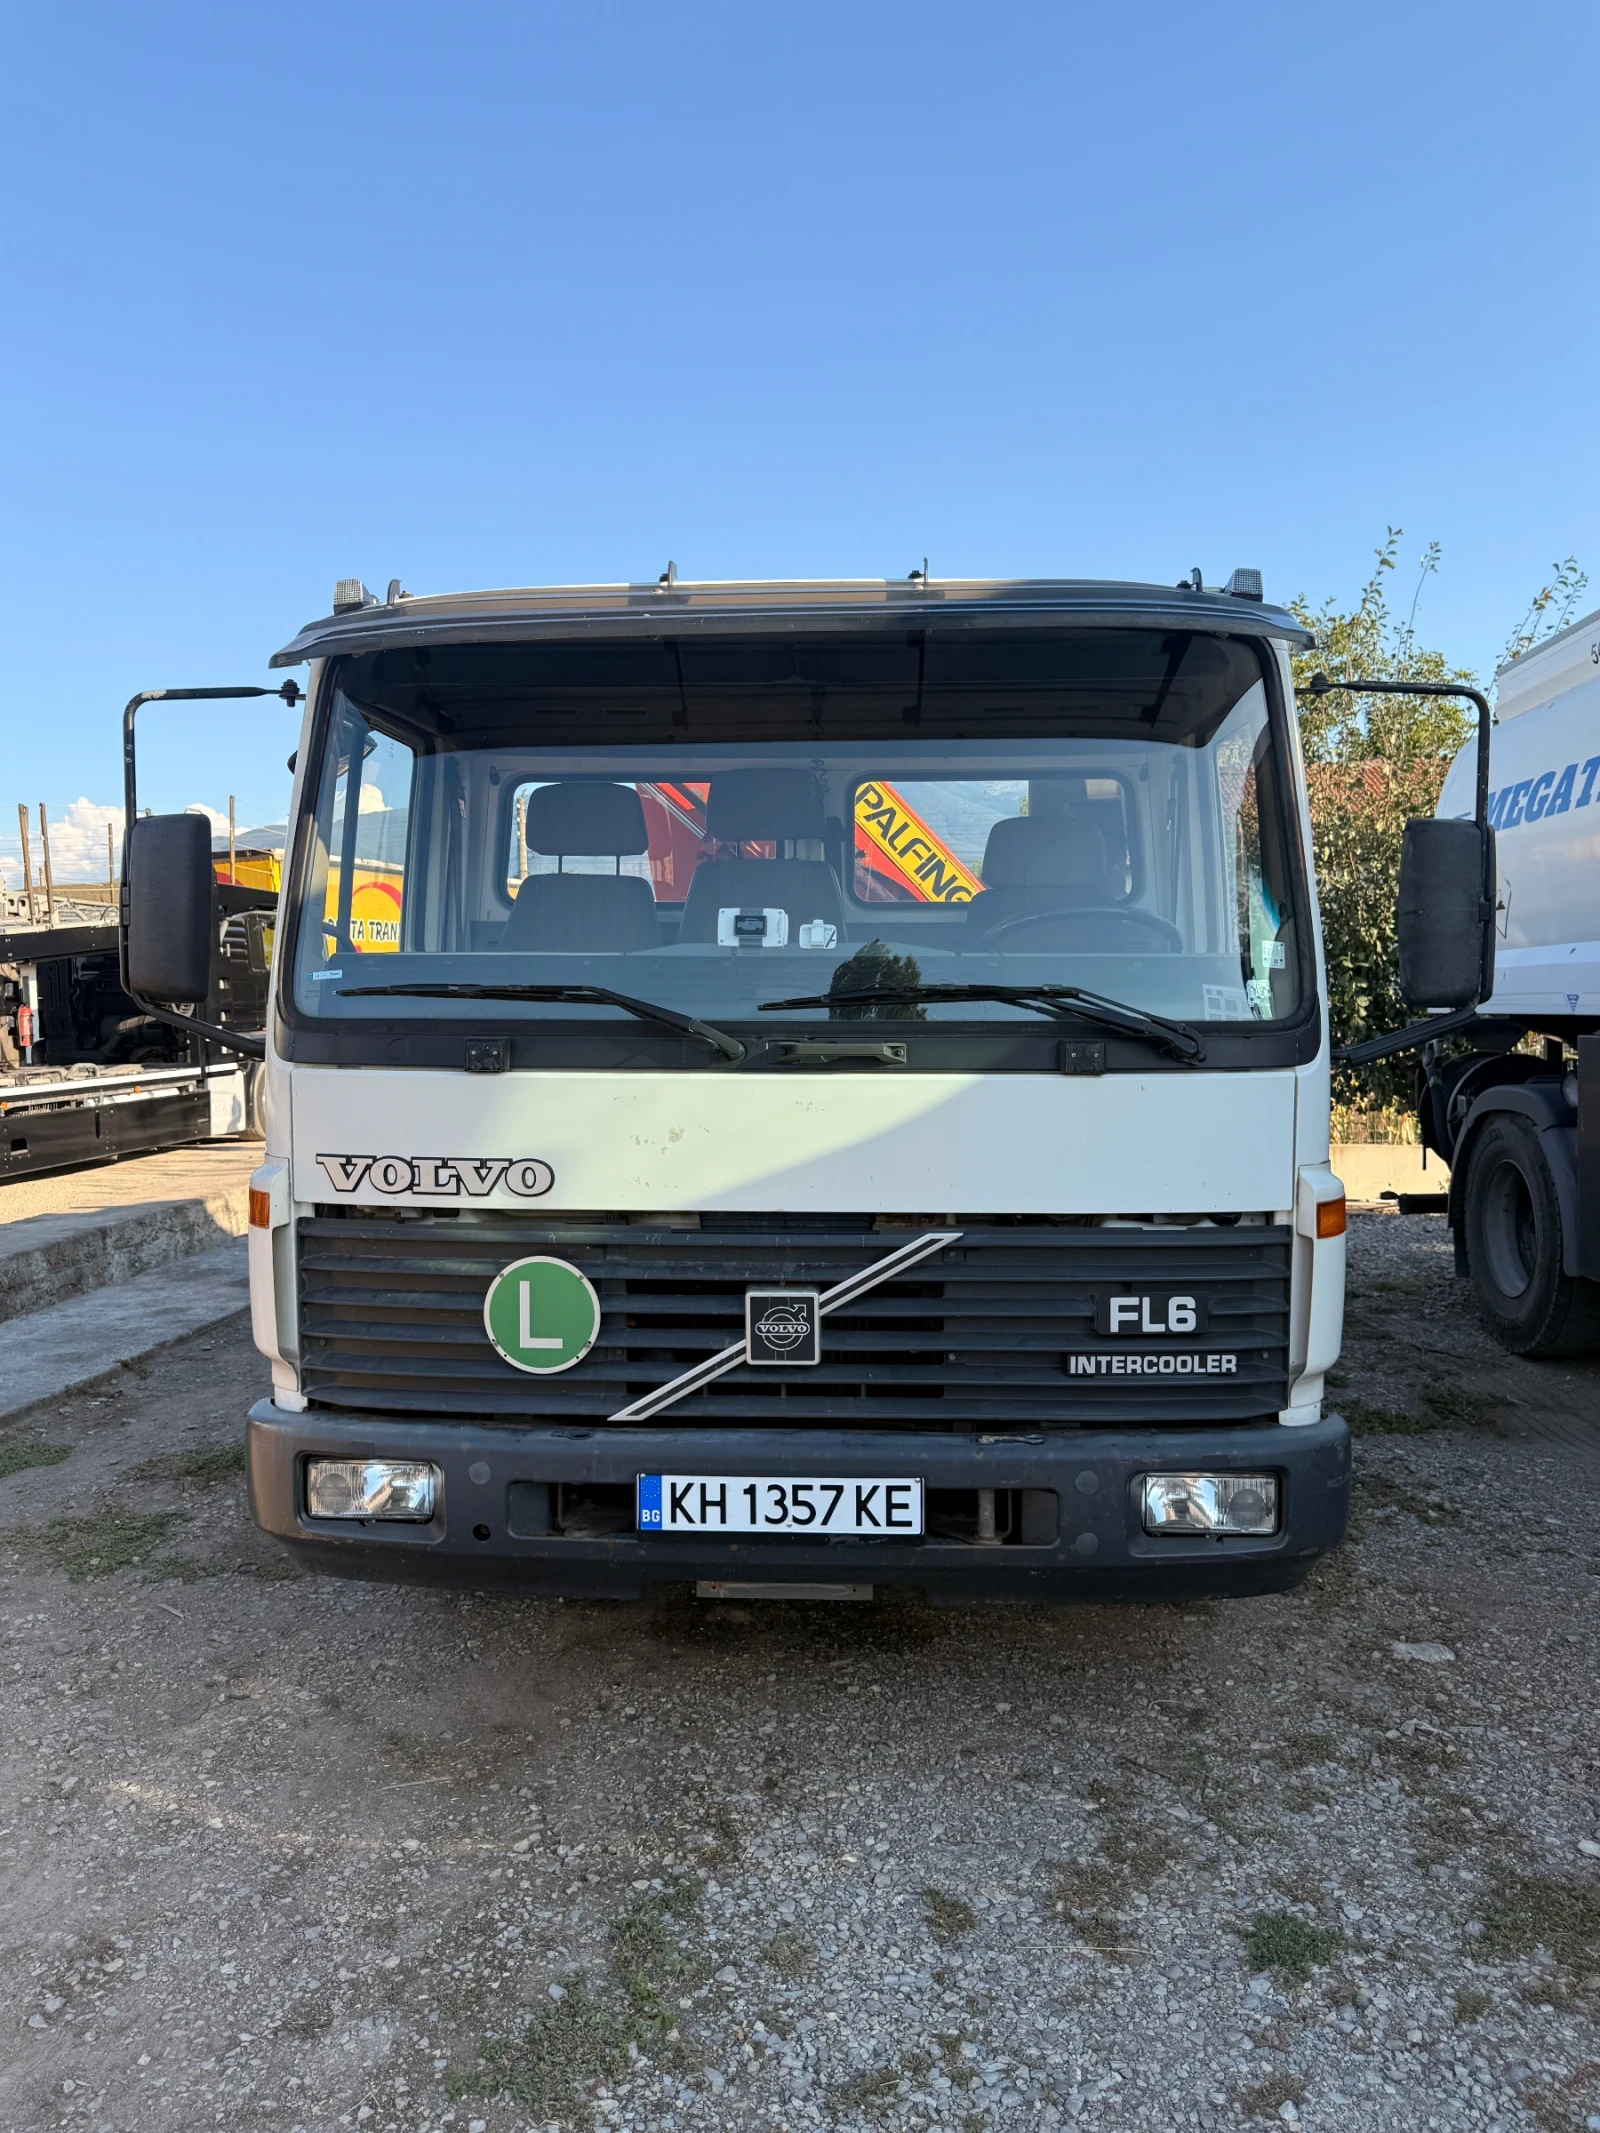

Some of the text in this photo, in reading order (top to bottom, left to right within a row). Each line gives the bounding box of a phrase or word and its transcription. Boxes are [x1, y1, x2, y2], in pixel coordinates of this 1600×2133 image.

[1591, 641, 1600, 665] 5
[369, 920, 401, 941] TRAN
[316, 1153, 555, 1198] VOLVO
[519, 1281, 564, 1349] L
[1110, 1296, 1197, 1333] FL6
[758, 1324, 808, 1333] VOLVO
[1070, 1355, 1237, 1374] INTERCOOLER
[642, 1509, 660, 1523] BG
[743, 1483, 844, 1526] 1357
